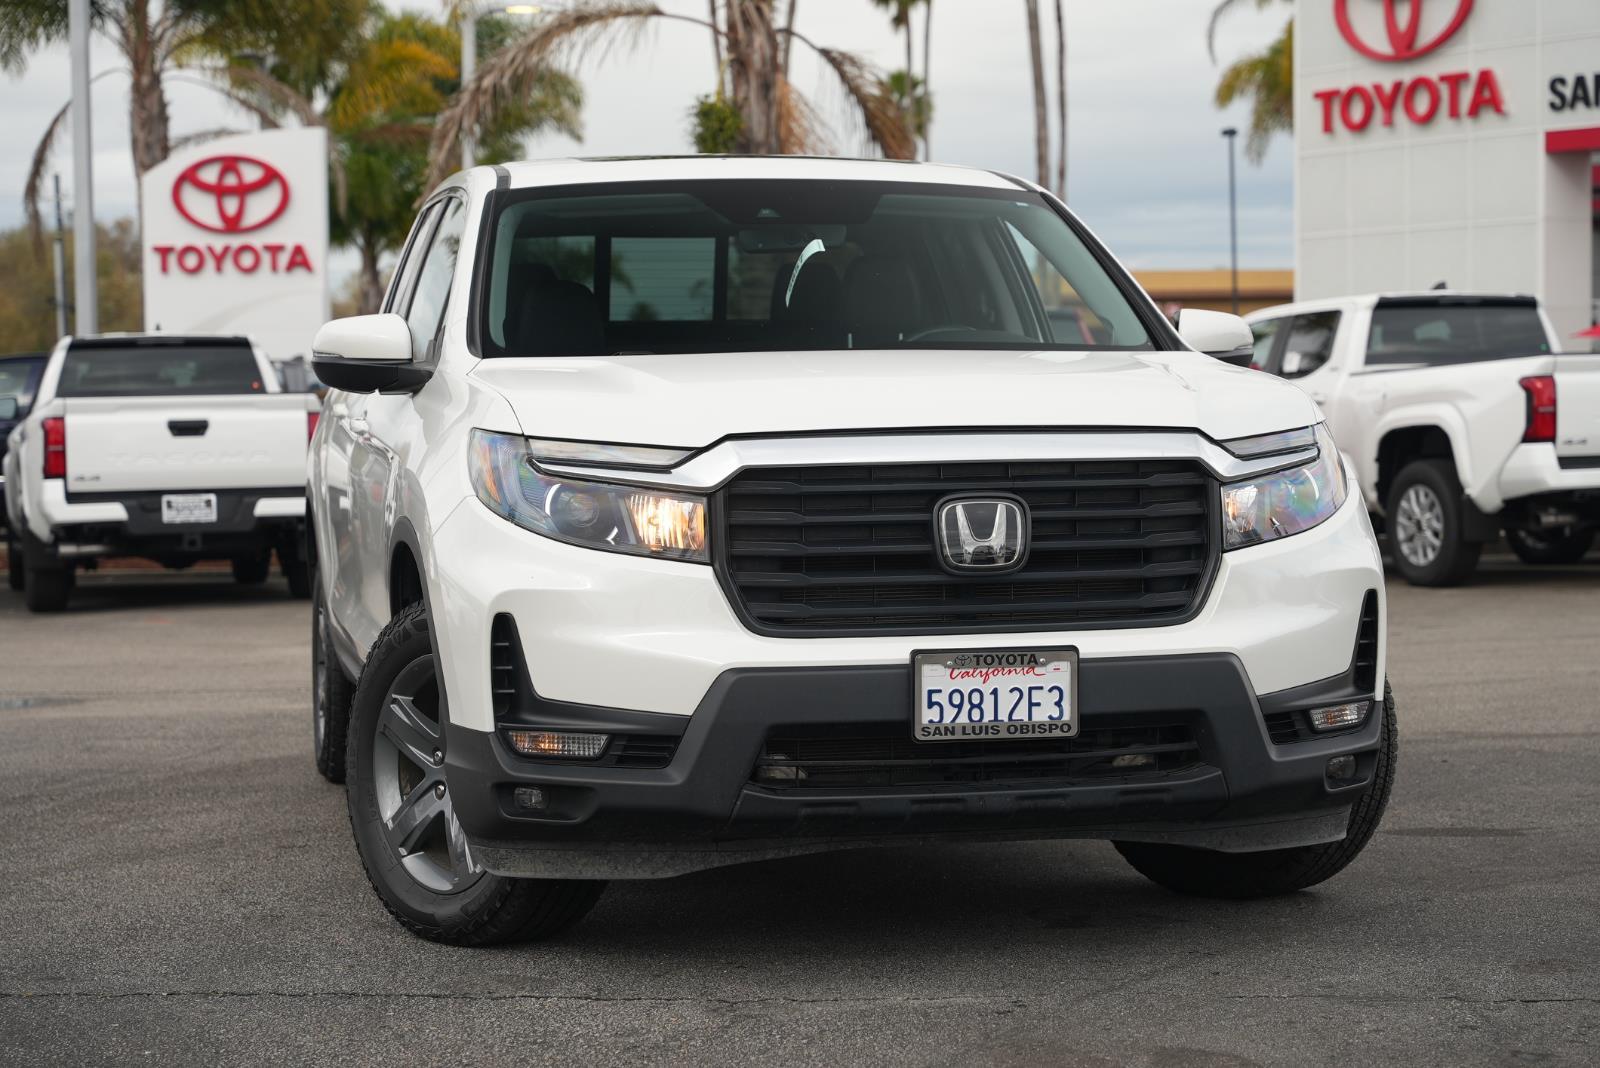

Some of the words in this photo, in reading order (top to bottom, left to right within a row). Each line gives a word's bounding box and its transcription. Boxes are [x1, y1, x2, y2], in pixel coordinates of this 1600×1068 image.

[1314, 68, 1505, 133] TOYOTA
[153, 244, 313, 274] TOYOTA
[972, 653, 1038, 666] TOYOTA
[949, 665, 1046, 684] California
[927, 685, 1064, 723] 59812F3
[921, 724, 956, 737] SAN
[962, 724, 1000, 736] LUIS
[1006, 722, 1072, 735] OBISPO
